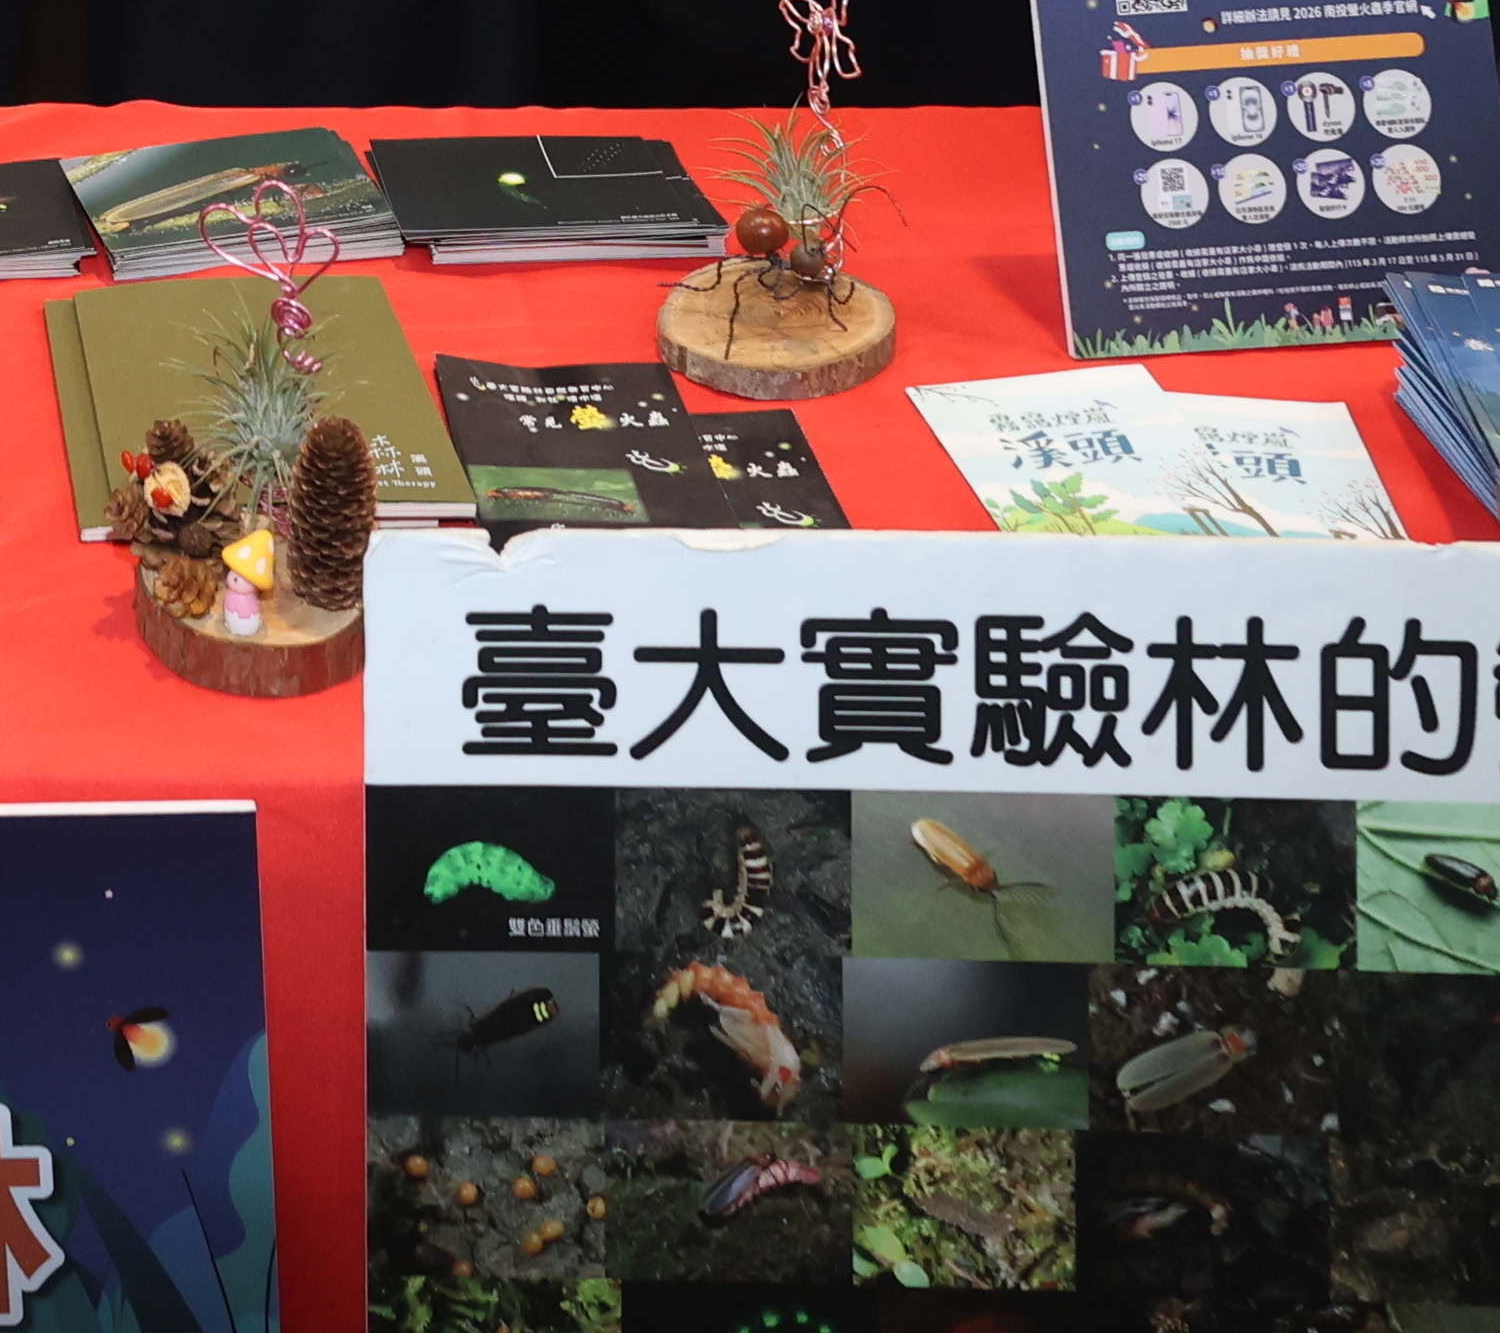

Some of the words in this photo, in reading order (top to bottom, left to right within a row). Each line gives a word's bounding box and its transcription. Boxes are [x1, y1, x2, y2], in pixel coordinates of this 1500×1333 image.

[519, 403, 670, 434] 常見螢火蟲
[998, 428, 1143, 471] 溪頭
